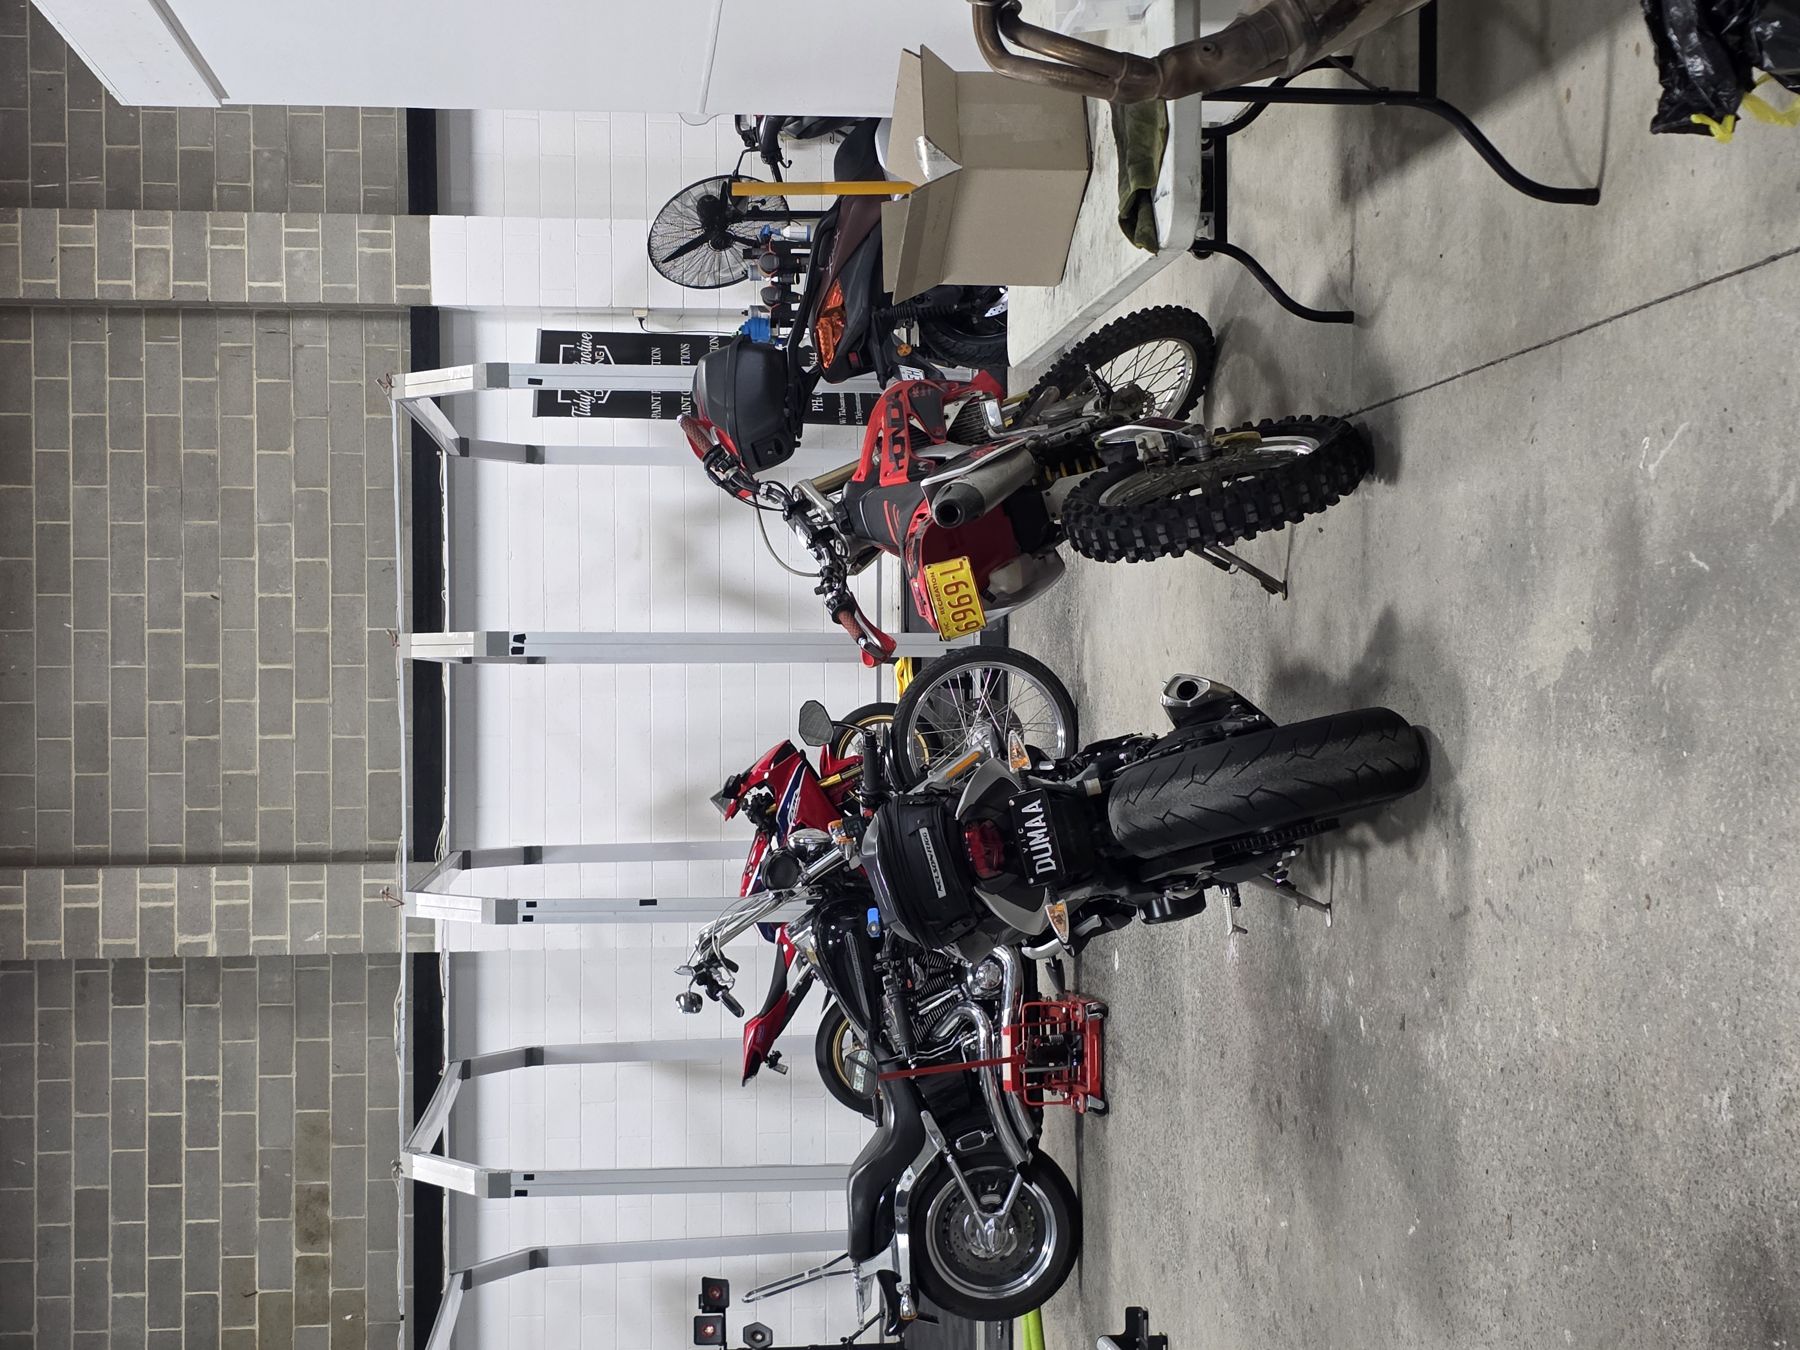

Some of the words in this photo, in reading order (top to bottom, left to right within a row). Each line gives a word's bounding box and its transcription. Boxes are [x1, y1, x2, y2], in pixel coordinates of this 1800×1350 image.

[681, 396, 691, 416] AINT
[929, 571, 945, 615] RECREATION
[1017, 827, 1029, 853] VIC
[1021, 798, 1057, 874] DUMAA
